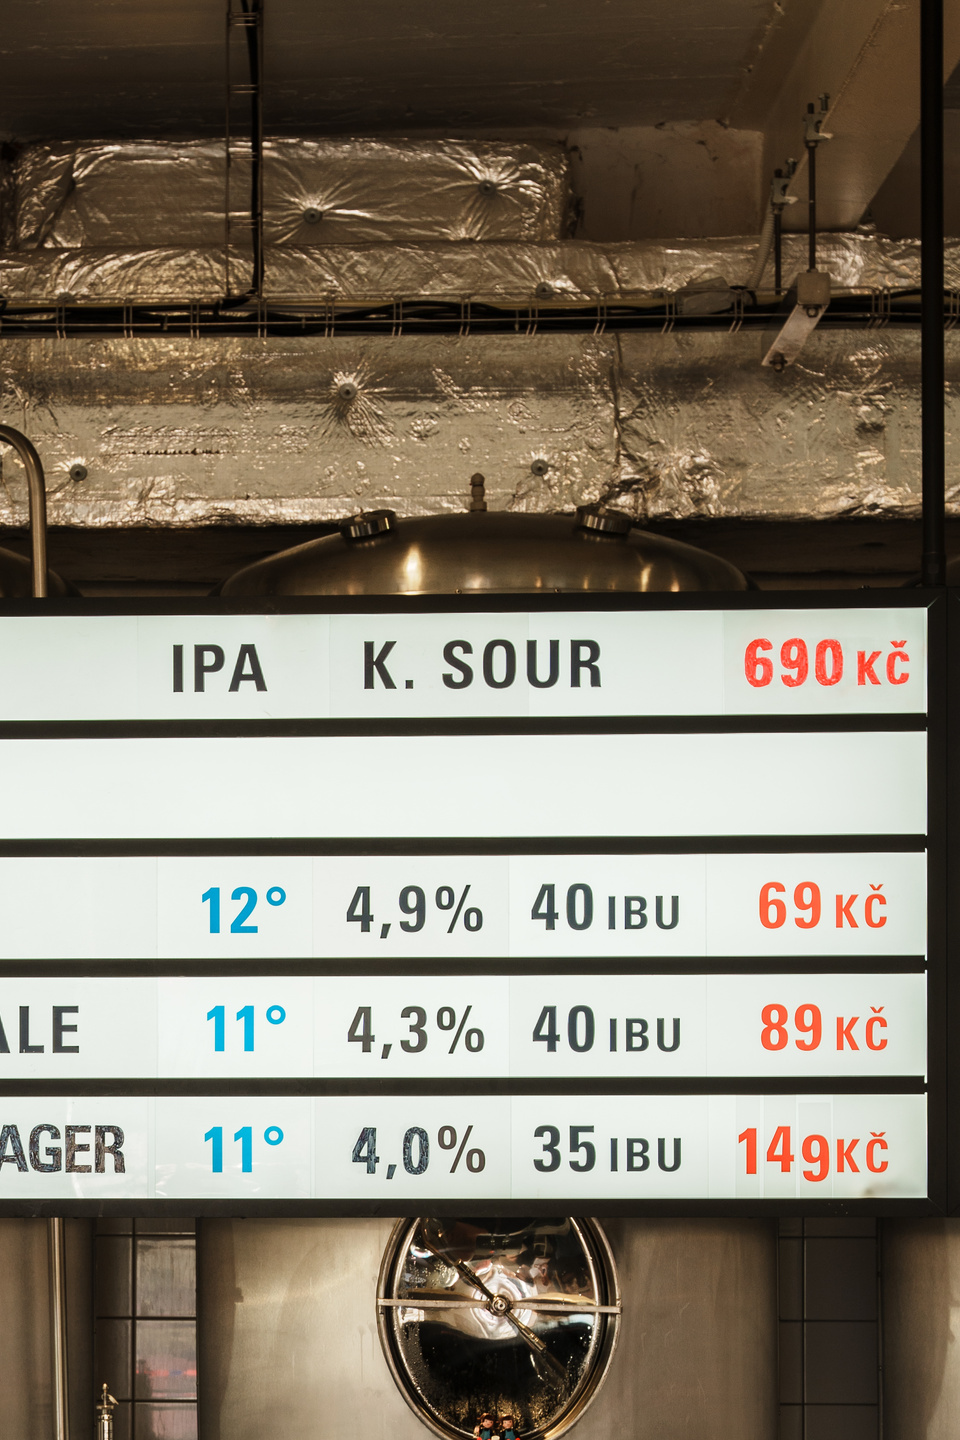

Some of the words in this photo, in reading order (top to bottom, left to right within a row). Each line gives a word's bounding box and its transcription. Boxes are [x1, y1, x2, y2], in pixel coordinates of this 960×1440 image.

[173, 644, 267, 692] IPA
[364, 641, 413, 689] K.
[442, 639, 601, 689] SOUR
[745, 638, 843, 687] 690
[857, 640, 909, 685] KČ
[202, 886, 286, 933] 12°
[347, 885, 483, 939] 4,9%
[531, 883, 593, 930] 40
[608, 896, 679, 930] IBU
[759, 881, 821, 929] 69
[836, 884, 887, 928] KČ
[207, 1005, 286, 1052] 11°
[348, 1005, 484, 1059] 4,3%
[533, 1005, 595, 1052] 40
[610, 1018, 680, 1052] IBU
[761, 1004, 822, 1051] 89
[837, 1007, 887, 1051] KČ
[204, 1126, 284, 1173] 11°
[352, 1125, 485, 1179] 4,0%
[533, 1125, 596, 1172] 35
[611, 1138, 681, 1172] IBU
[738, 1126, 829, 1182] 149
[837, 1132, 888, 1173] KČ
